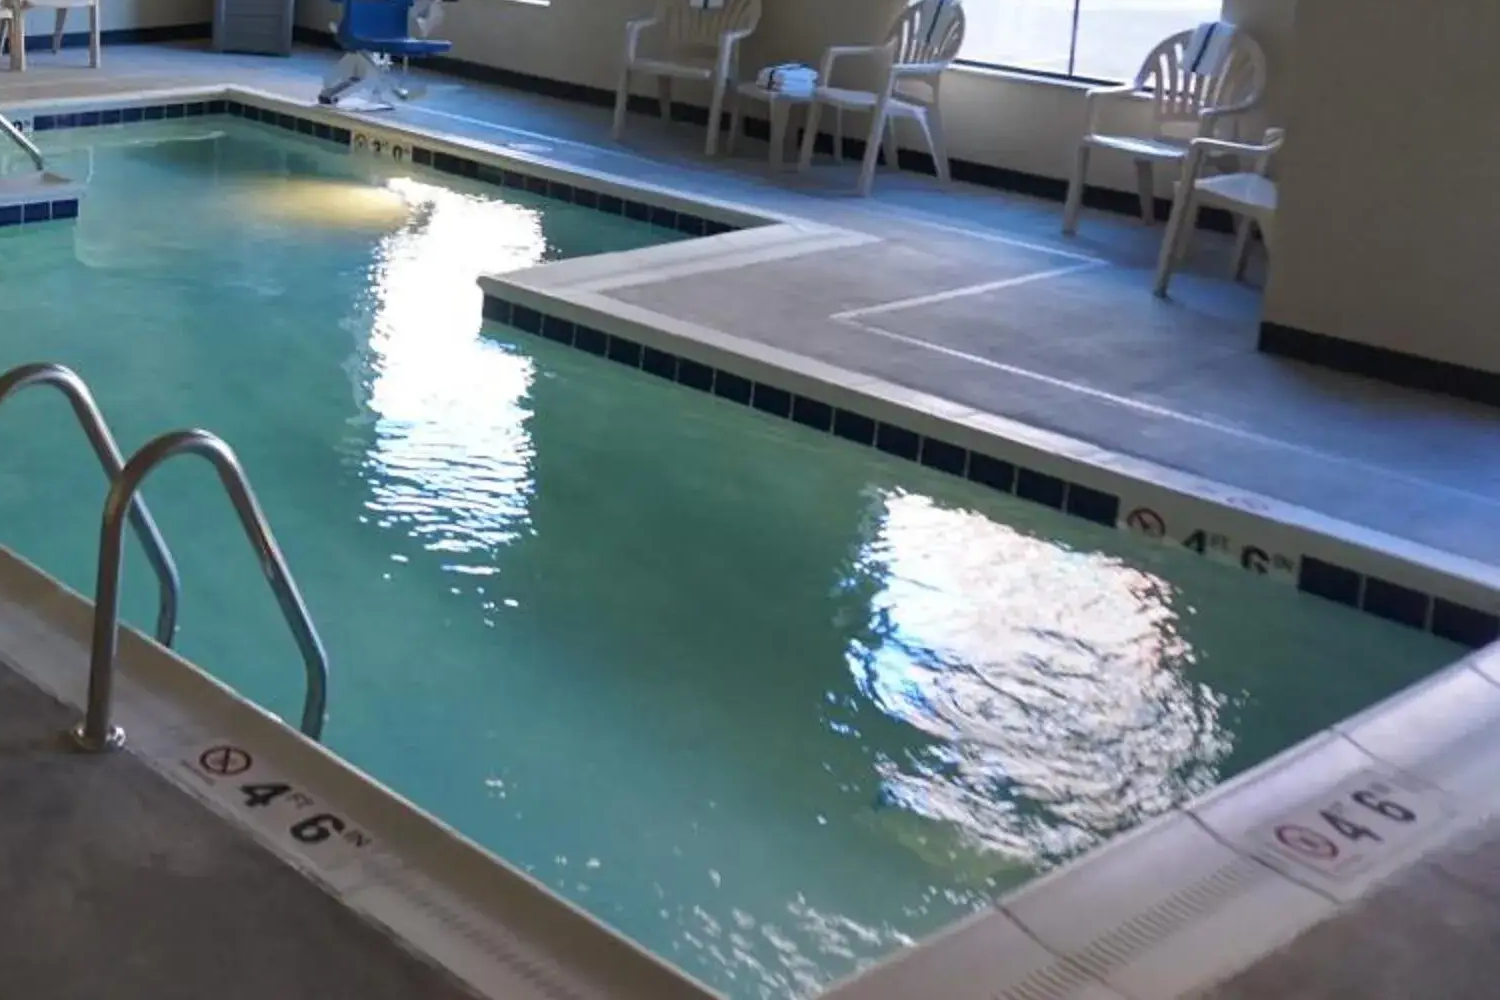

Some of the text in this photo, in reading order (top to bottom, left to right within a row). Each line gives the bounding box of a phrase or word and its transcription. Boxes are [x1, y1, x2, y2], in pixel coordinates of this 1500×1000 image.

[1182, 528, 1206, 555] 4
[240, 781, 291, 808] 4
[290, 813, 346, 844] 6
[1350, 789, 1418, 823] 6
[1319, 809, 1384, 844] 4
